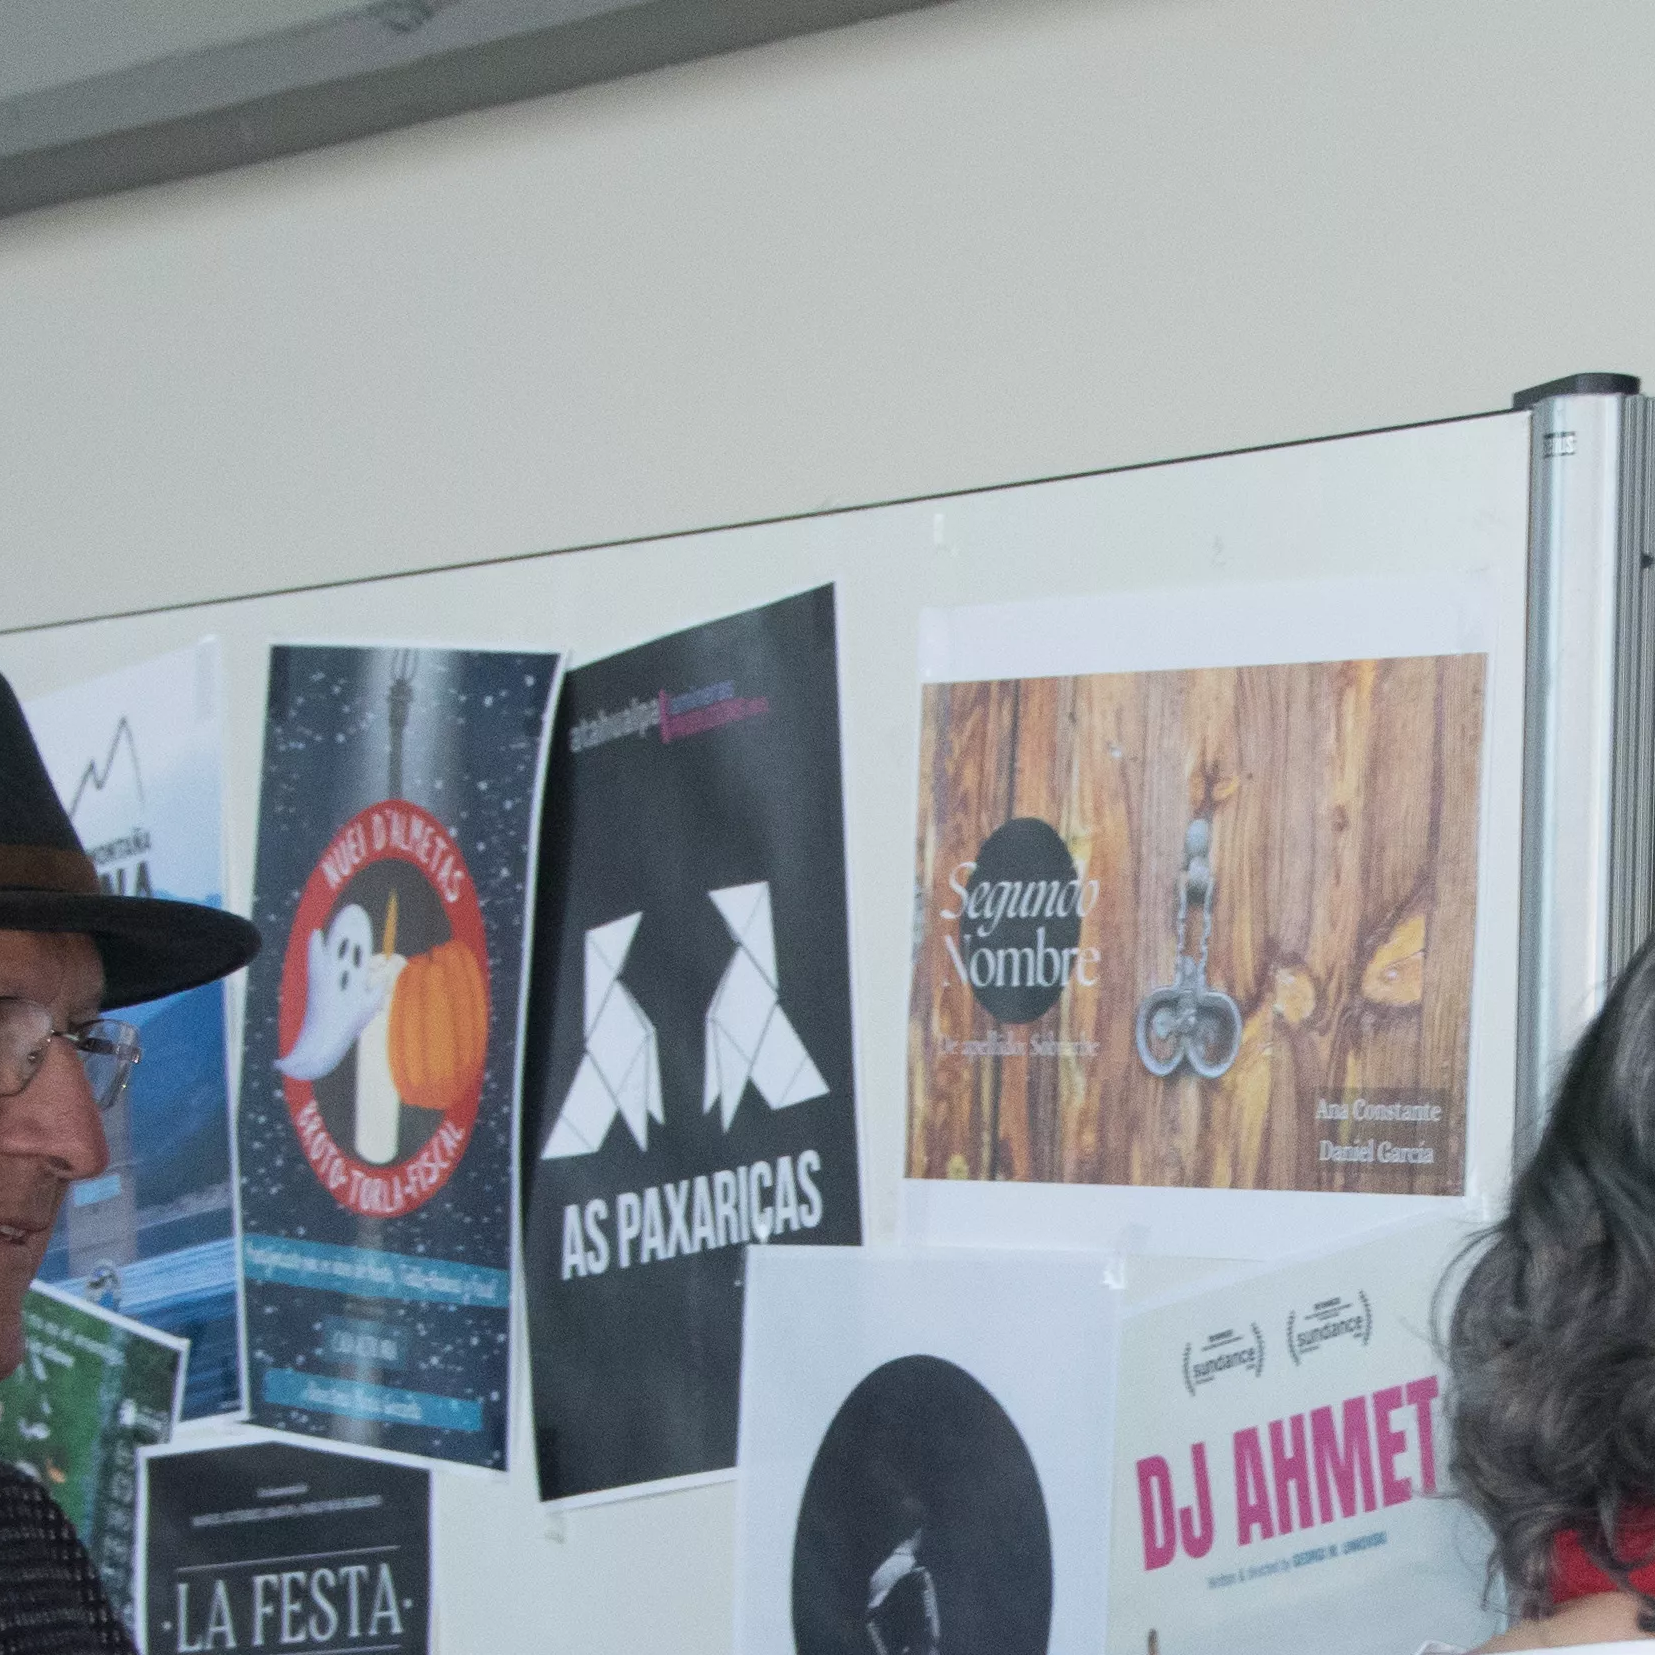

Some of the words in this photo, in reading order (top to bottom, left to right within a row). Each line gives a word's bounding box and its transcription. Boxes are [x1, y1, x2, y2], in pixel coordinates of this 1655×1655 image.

[940, 860, 1101, 937] Segundo
[945, 926, 1102, 988] Nombre
[1316, 1098, 1349, 1120] Ana
[1352, 1098, 1442, 1122] Constante
[1319, 1138, 1375, 1163] Daniel
[1377, 1140, 1435, 1164] García
[562, 1199, 610, 1281] AS
[1136, 1455, 1214, 1572] DJ
[1232, 1375, 1439, 1547] AHMET
[177, 1580, 237, 1654] LA
[252, 1563, 404, 1645] FESTA
